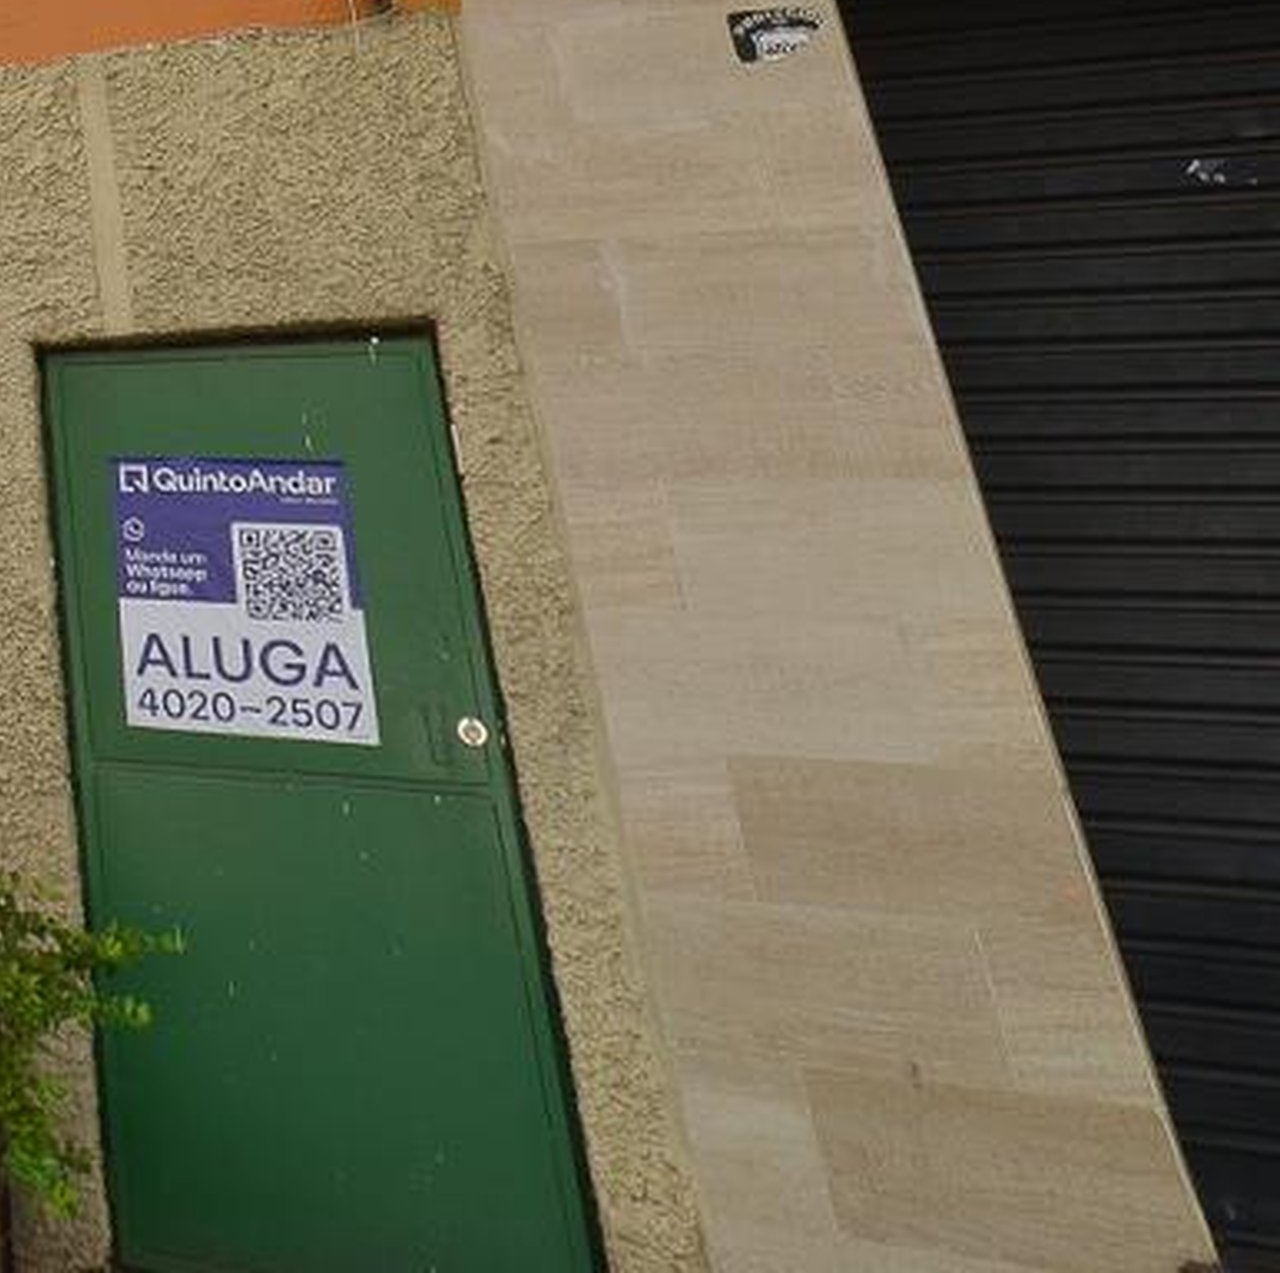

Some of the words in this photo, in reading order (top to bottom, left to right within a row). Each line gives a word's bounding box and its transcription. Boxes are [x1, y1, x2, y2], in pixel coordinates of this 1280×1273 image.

[151, 466, 337, 496] QuintoAndar
[137, 633, 359, 690] ALUGA
[138, 688, 363, 732] 4020-2507
